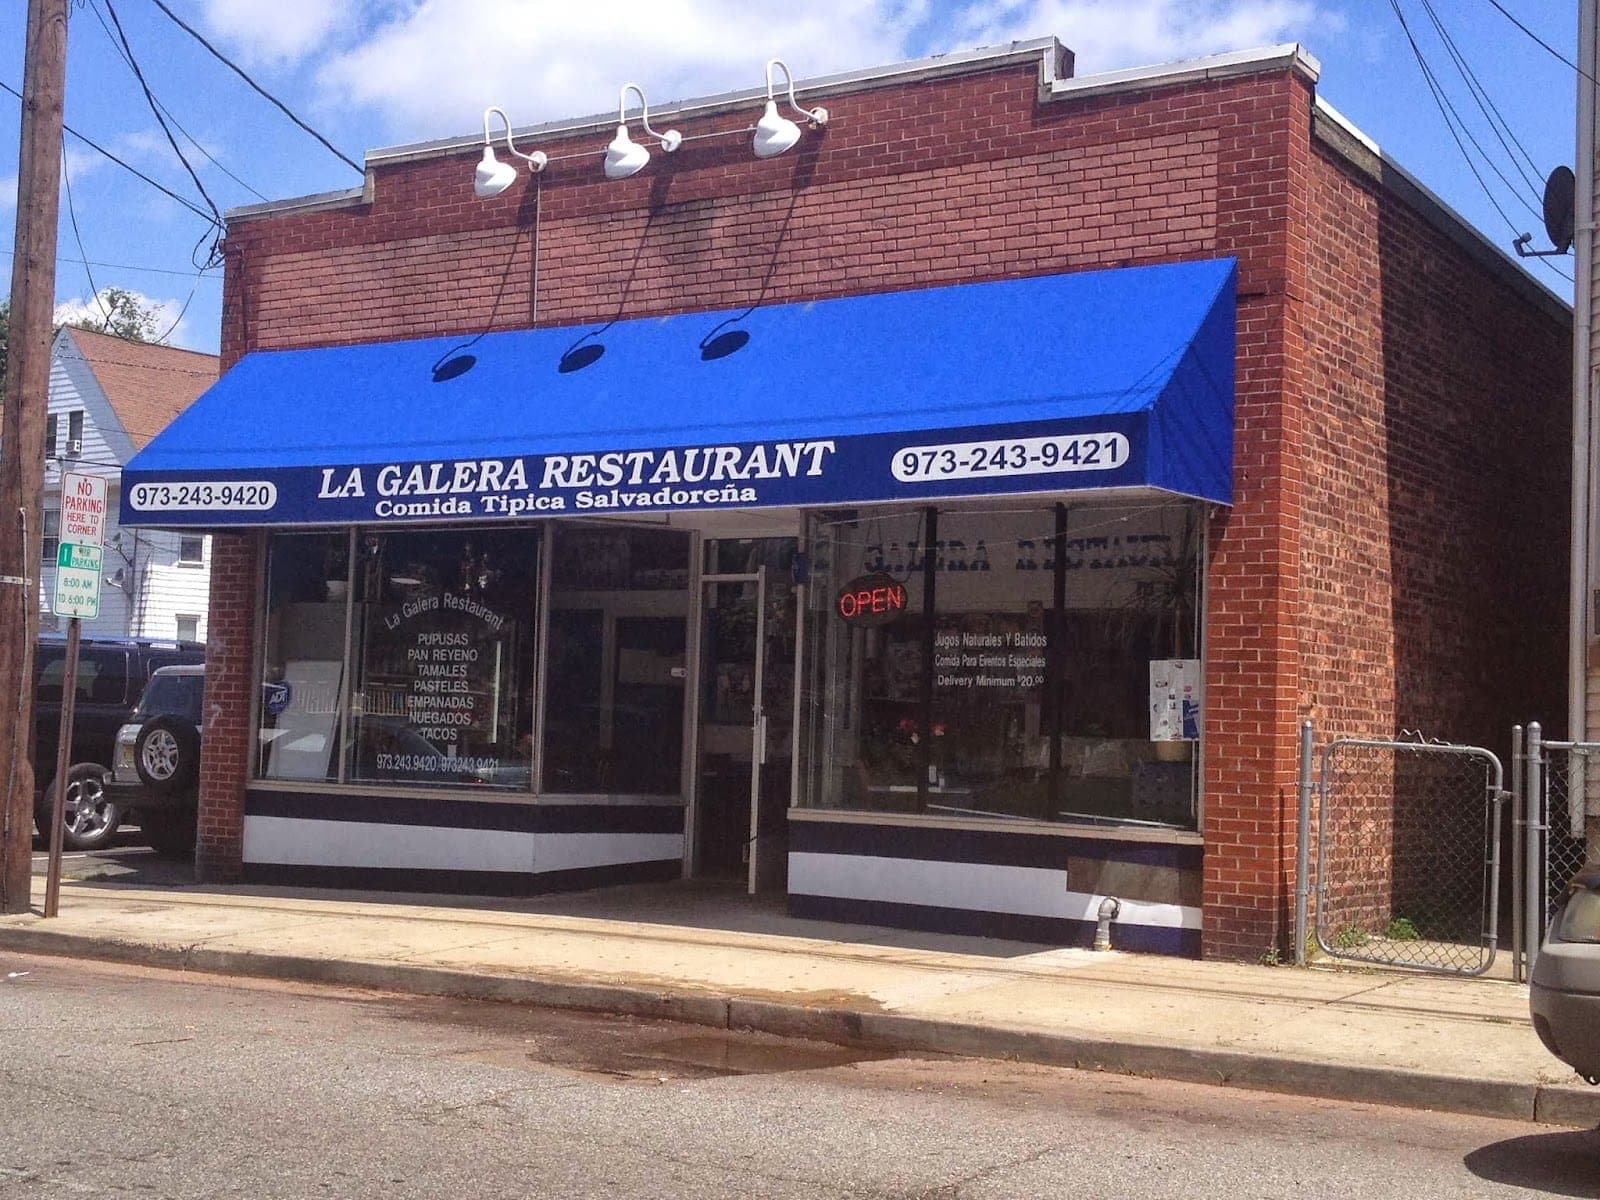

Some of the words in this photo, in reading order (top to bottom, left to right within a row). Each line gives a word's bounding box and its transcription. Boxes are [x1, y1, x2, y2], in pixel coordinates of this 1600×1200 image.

[902, 438, 1118, 476] 973-243-9421
[318, 467, 365, 499] LA
[376, 460, 528, 495] GALERA
[539, 440, 836, 489] RESTAURANT
[77, 482, 93, 497] NO
[136, 485, 270, 506] 973-243-9420
[65, 496, 102, 514] PARKING
[375, 496, 472, 517] Comida
[480, 493, 566, 516] Tipica
[575, 484, 757, 509] Salvadoreña
[67, 512, 86, 524] HERE
[90, 514, 99, 525] TO
[68, 523, 97, 537] CORNER
[72, 557, 99, 569] PARKING
[82, 579, 92, 589] AM
[58, 593, 66, 603] TO
[87, 597, 97, 606] PM
[840, 586, 902, 618] OPEN
[384, 612, 401, 630] La
[402, 596, 439, 618] Galera
[444, 592, 504, 630] Restaurant
[418, 633, 469, 645] PUPUSAS
[935, 632, 960, 650] Jugos
[962, 632, 1002, 647] Naturales
[1006, 632, 1012, 646] Y
[1014, 632, 1047, 647] Batidos
[408, 649, 428, 661] PAN
[433, 649, 478, 661] REYENO
[935, 654, 960, 667] Comida
[962, 654, 977, 667] Para
[979, 654, 1006, 667] Eventos
[1008, 654, 1046, 669] Especiales
[418, 664, 467, 677] TAMALES
[414, 680, 469, 692] PASTELES
[937, 675, 973, 688] Delivery
[976, 675, 1015, 687] Minimum
[269, 691, 286, 704] ADT
[407, 695, 474, 709] EMPANADAS
[409, 711, 471, 725] NUEGADOS
[421, 727, 457, 740] TACOS
